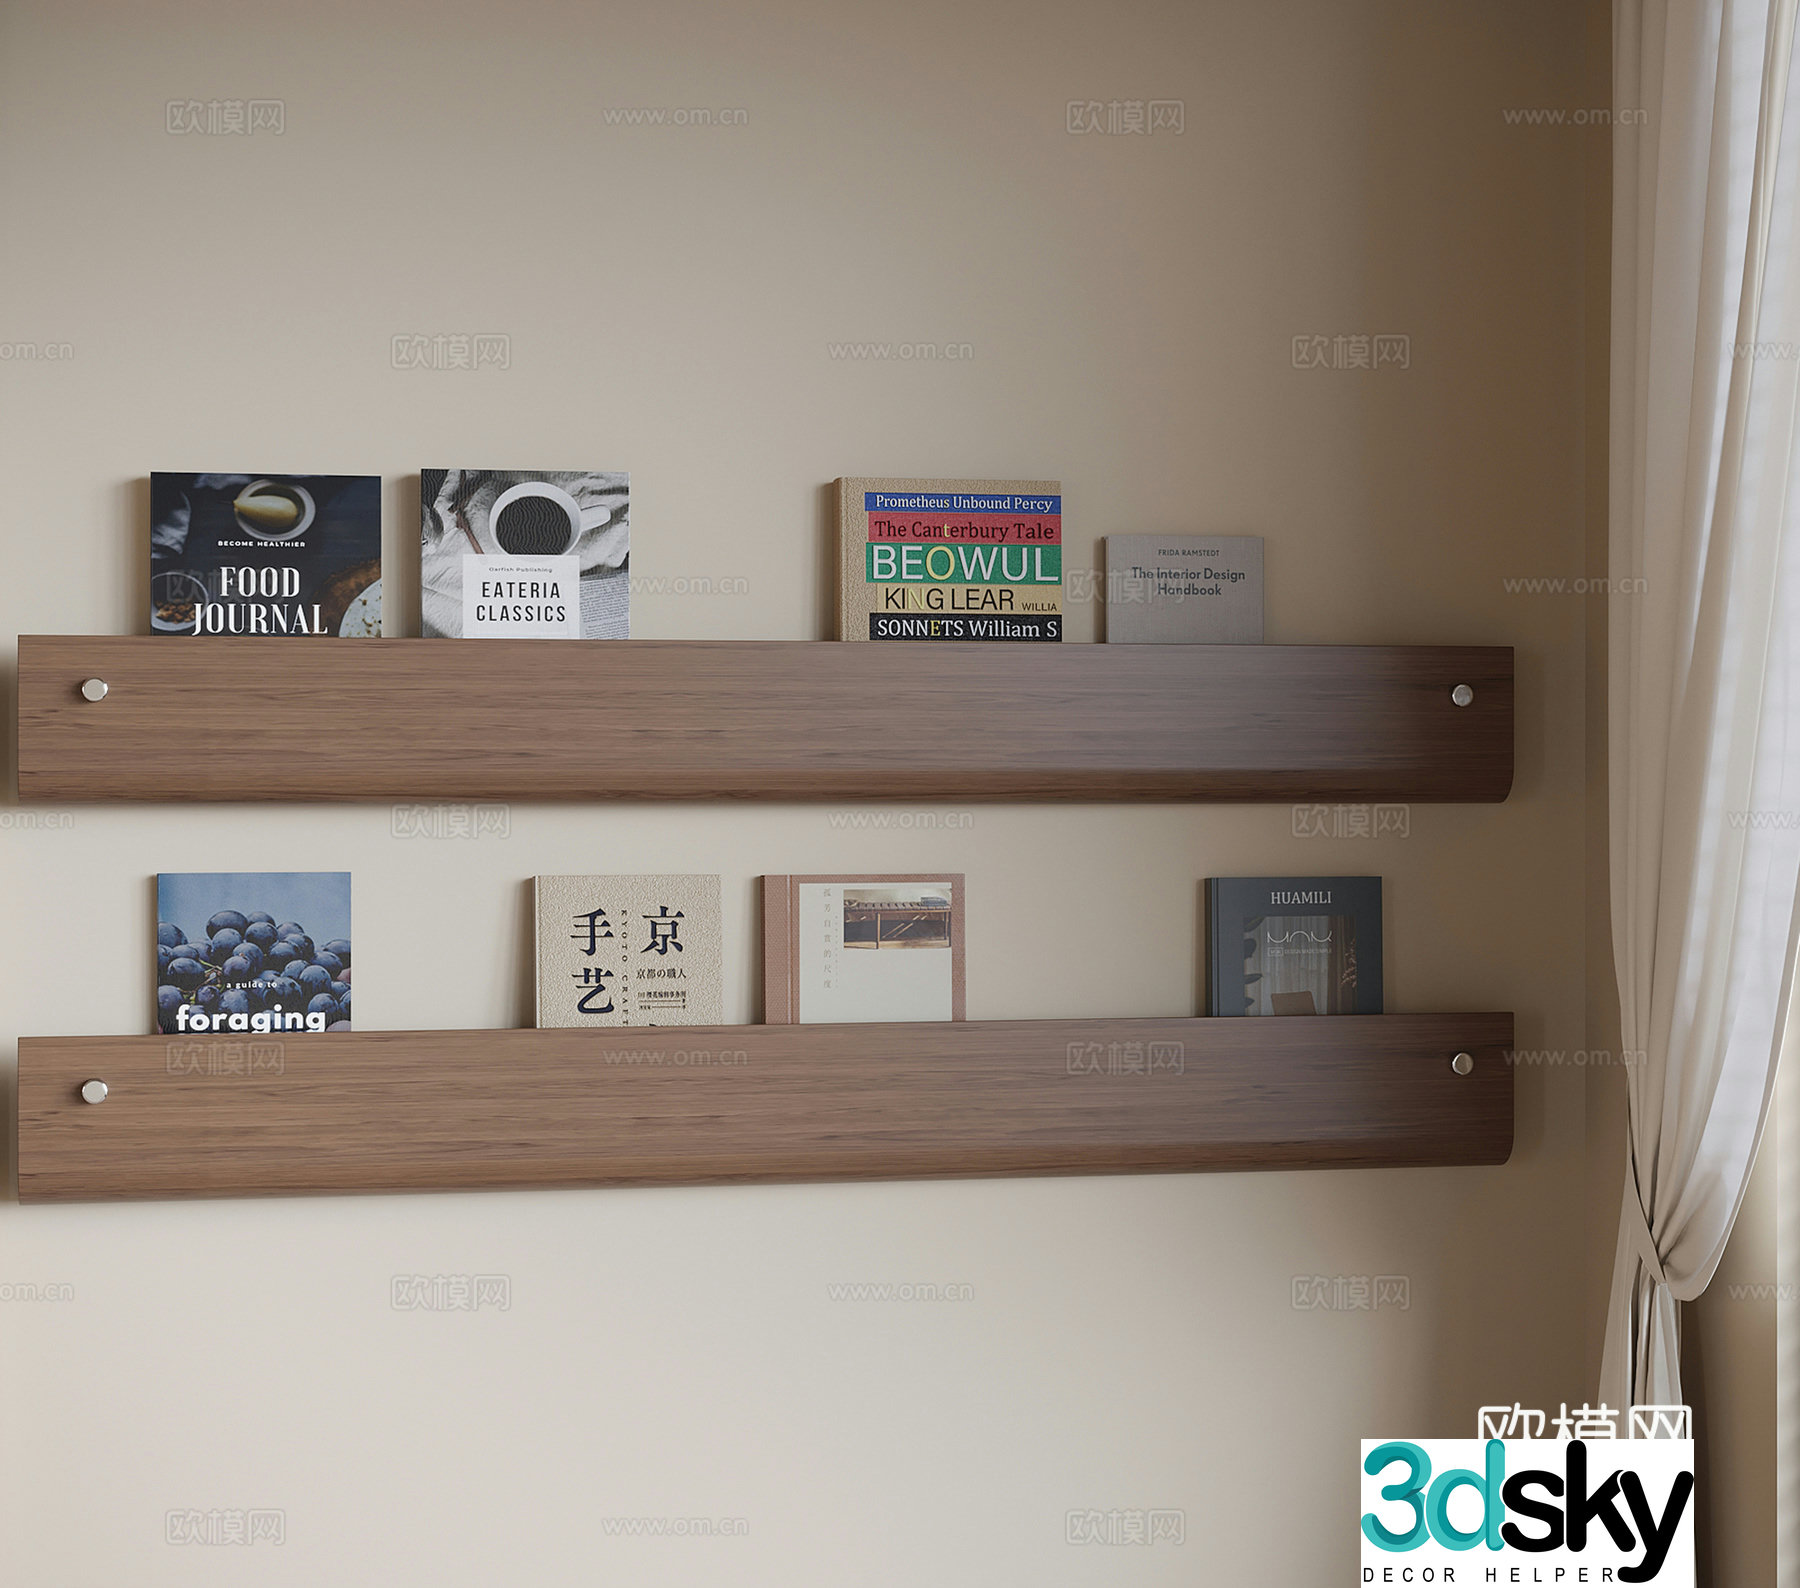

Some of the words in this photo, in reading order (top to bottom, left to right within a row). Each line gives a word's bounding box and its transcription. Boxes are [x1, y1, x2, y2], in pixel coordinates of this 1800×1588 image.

[876, 495, 950, 509] Prometheus
[953, 496, 1011, 510] Unbound
[1014, 497, 1053, 513] Percy
[875, 521, 907, 537] The
[912, 522, 1009, 543] Canterbury
[1013, 523, 1054, 540] Tale
[1182, 549, 1220, 557] RAMSTEDT
[872, 545, 1059, 582] BEOWUL
[219, 566, 300, 598] FOOD
[1132, 567, 1154, 579] The
[1156, 567, 1201, 580] Interior
[1204, 568, 1246, 583] Design
[482, 582, 561, 598] EATERIA
[1157, 583, 1222, 596] Handbook
[885, 587, 944, 611] KING
[951, 588, 1014, 611] LEAR
[1021, 602, 1058, 612] WILLIA
[192, 603, 328, 636] JOURNAL
[476, 605, 566, 622] CLASSICS
[877, 619, 964, 637] SONNETS
[968, 619, 1040, 637] William
[1046, 621, 1057, 637] S
[1271, 891, 1332, 904] HUAMILI
[640, 905, 685, 955] 京
[570, 908, 615, 1014] 手艺
[235, 981, 263, 989] guide
[176, 1003, 326, 1033] foraging
